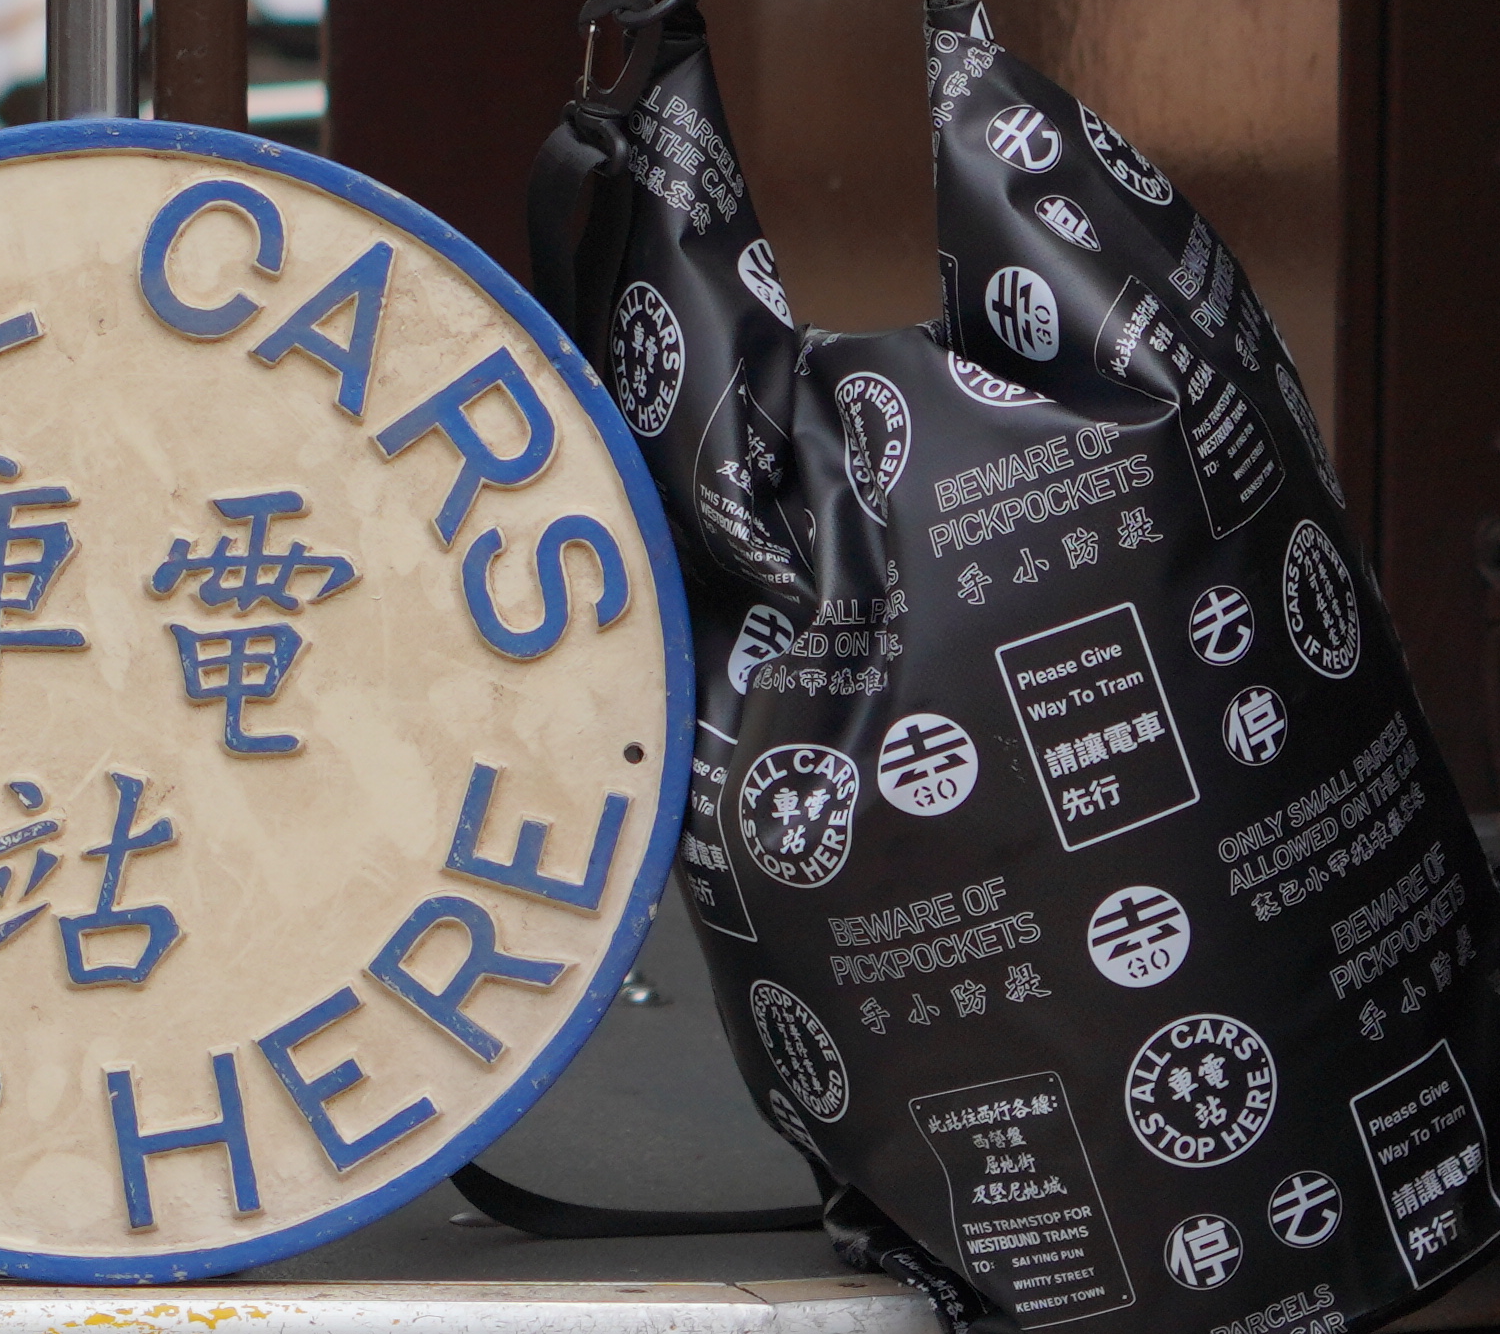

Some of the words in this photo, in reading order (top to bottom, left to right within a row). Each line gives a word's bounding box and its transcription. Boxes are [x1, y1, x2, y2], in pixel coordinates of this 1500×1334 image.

[656, 126, 705, 175] THE
[702, 168, 737, 223] CAR
[619, 289, 642, 331] ALL
[645, 292, 680, 370] CARS
[614, 338, 635, 412] STOP
[865, 381, 903, 432] HERE
[957, 356, 1026, 400] STOP
[140, 177, 633, 661] CARS
[934, 437, 1074, 512] BEWARE
[1076, 423, 1119, 459] OF
[928, 455, 1153, 558] PICKPOCKETS
[1293, 527, 1314, 564] STOP
[1288, 563, 1303, 632] CARS
[1018, 660, 1077, 690] Please
[1081, 642, 1122, 668] Give
[1304, 635, 1321, 656] IF
[1027, 694, 1068, 722] Way
[1069, 685, 1094, 707] To
[1096, 671, 1144, 698] Tram
[1228, 690, 1285, 761] 停
[744, 757, 788, 809] ALL
[793, 749, 857, 801] CARS
[1063, 775, 1121, 822] 先行
[743, 818, 796, 881] STOP
[800, 809, 849, 882] HERE
[1218, 810, 1283, 863] ONLY
[1287, 769, 1357, 828] SMALL
[1230, 817, 1339, 896] ALLOWED
[1340, 791, 1371, 829] ON
[1367, 765, 1401, 807] THE
[829, 893, 956, 947] BEWARE
[962, 877, 1007, 917] OF
[1331, 863, 1428, 955] BEWARE
[1423, 841, 1446, 884] OF
[830, 912, 1041, 987] PICKPOCKETS
[1329, 873, 1465, 999] PICKPOCKETS
[107, 757, 635, 1231] HERE
[796, 1005, 838, 1062] HERE
[1132, 1049, 1171, 1103] ALL
[1171, 1020, 1259, 1060] CARS
[1140, 1113, 1215, 1160] STOP
[1221, 1067, 1270, 1151] HERE
[1369, 1100, 1418, 1137] Please
[1419, 1079, 1450, 1106] Give
[1378, 1138, 1410, 1165] Way
[1410, 1127, 1430, 1146] To
[1431, 1104, 1466, 1133] Tram
[963, 1222, 992, 1236] THIS
[993, 1213, 1061, 1232] TRAMSTOP
[1064, 1206, 1092, 1222] FOR
[967, 1231, 1041, 1254] WESTBOUND
[1043, 1226, 1089, 1243] TRAMS
[1168, 1217, 1239, 1286] 停
[1012, 1257, 1031, 1268] SAI
[1032, 1251, 1059, 1264] YING
[1061, 1248, 1085, 1259] PUN
[1013, 1277, 1053, 1290] WHITTY
[1054, 1267, 1095, 1284] STREET
[1015, 1295, 1069, 1313] KENNEDY
[1071, 1286, 1105, 1301] TOWN
